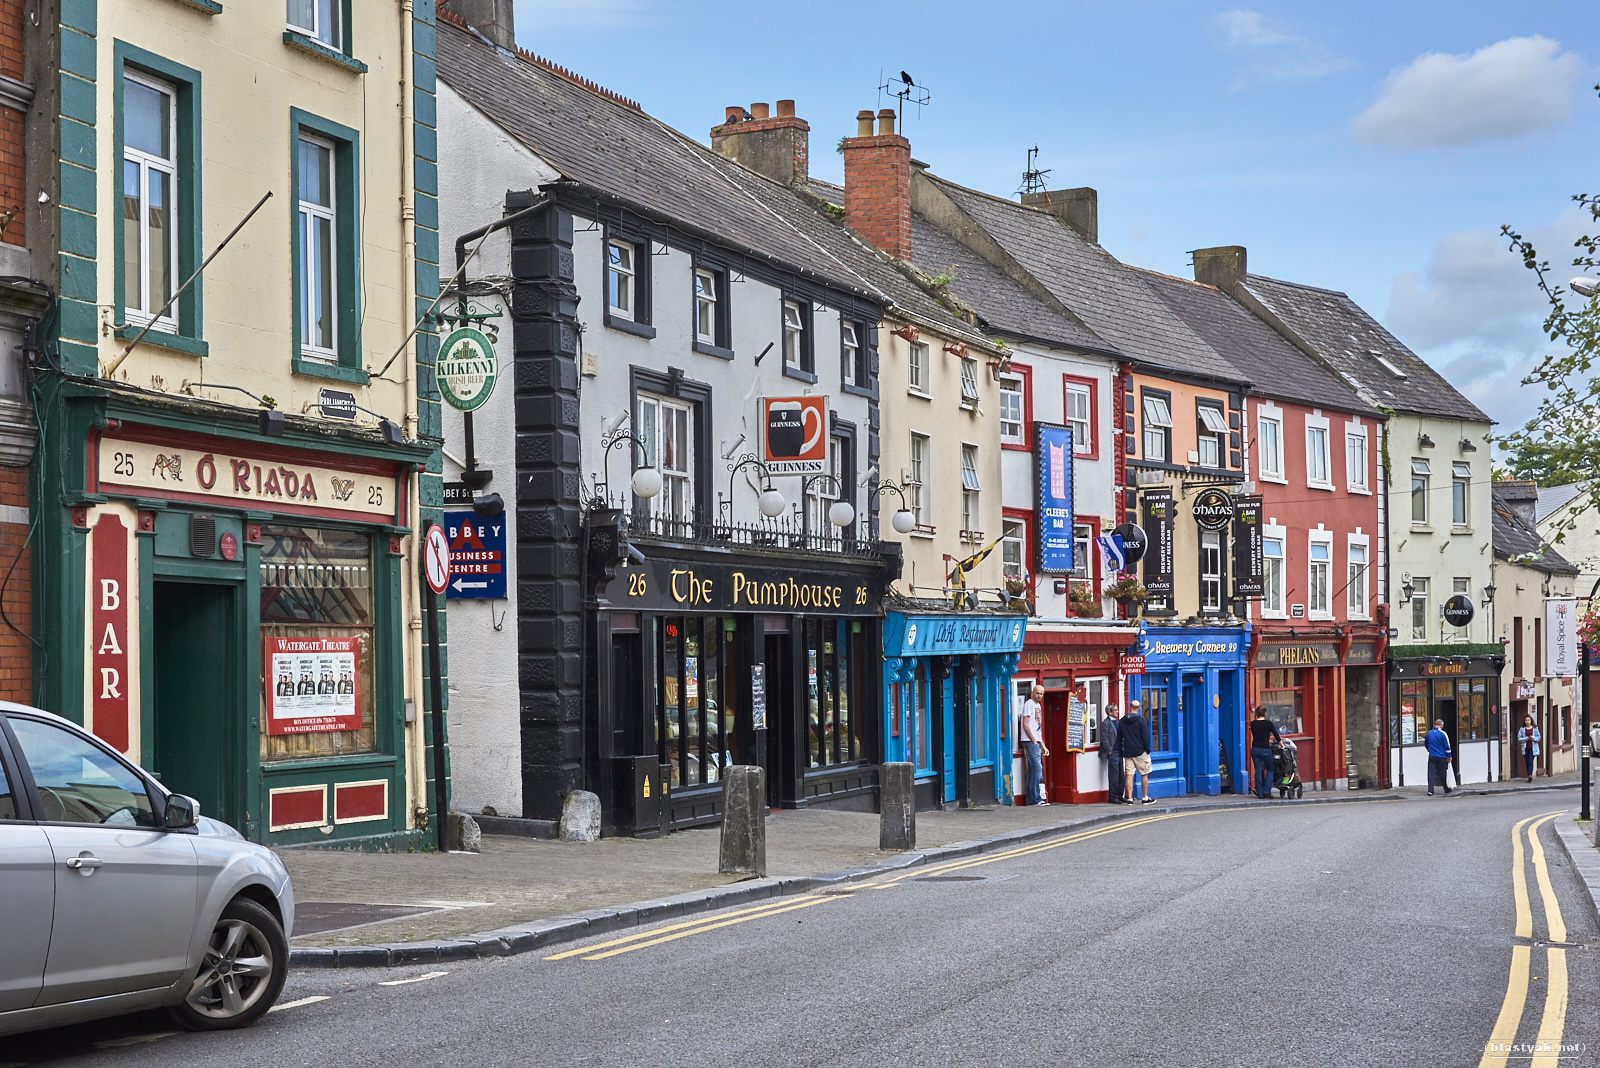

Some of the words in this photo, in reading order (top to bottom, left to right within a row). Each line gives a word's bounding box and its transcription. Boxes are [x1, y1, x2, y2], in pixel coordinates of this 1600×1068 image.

[438, 360, 495, 376] KILKENNY
[448, 376, 466, 384] IRISH
[468, 376, 484, 384] BEER
[769, 461, 821, 472] GUINNESS
[114, 452, 134, 476] 25
[368, 486, 383, 506] 25
[443, 489, 460, 498] BBEY
[1046, 508, 1069, 518] CLEERE'S
[1053, 519, 1064, 528] BAR
[450, 552, 494, 560] USINESS
[628, 573, 646, 596] 26
[855, 586, 867, 605] 26
[1557, 620, 1566, 641] Spice
[98, 578, 122, 699] BAR
[278, 640, 320, 650] WATERGATE
[321, 639, 350, 650] THEATRE
[1026, 652, 1050, 665] JOHN
[1057, 652, 1092, 664] CLEERE
[1279, 647, 1319, 664] PHELANS
[1557, 644, 1566, 664] Royal
